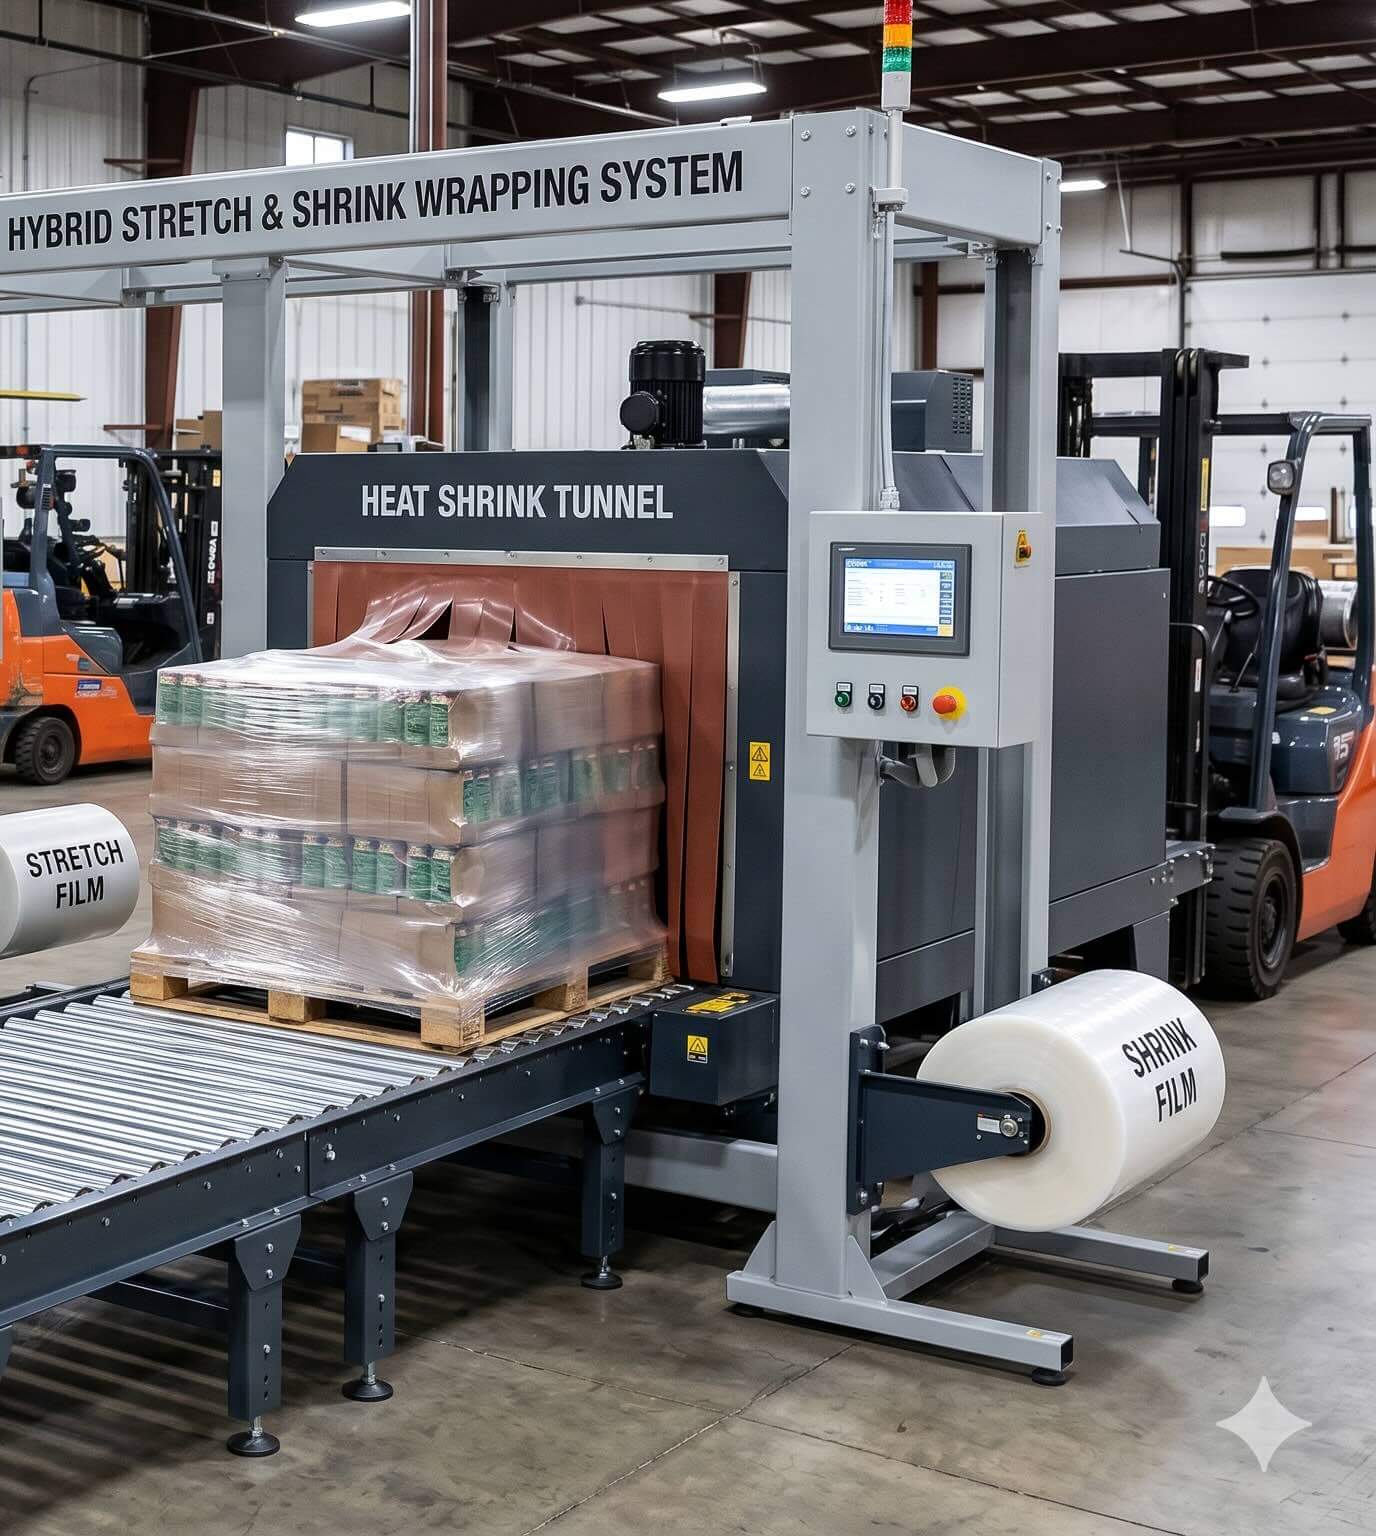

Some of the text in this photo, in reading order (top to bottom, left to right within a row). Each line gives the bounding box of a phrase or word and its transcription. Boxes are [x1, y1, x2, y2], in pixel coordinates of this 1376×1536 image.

[8, 150, 744, 252] HYBRID STRETCH & SHRINK WRAPPING SYSTEM
[361, 484, 675, 520] HEAT SHRINK TUNNEL
[25, 839, 124, 878] STRETCH
[55, 876, 105, 910] FILM
[1121, 1017, 1198, 1078] SHRINK
[1154, 1067, 1198, 1123] FILM
